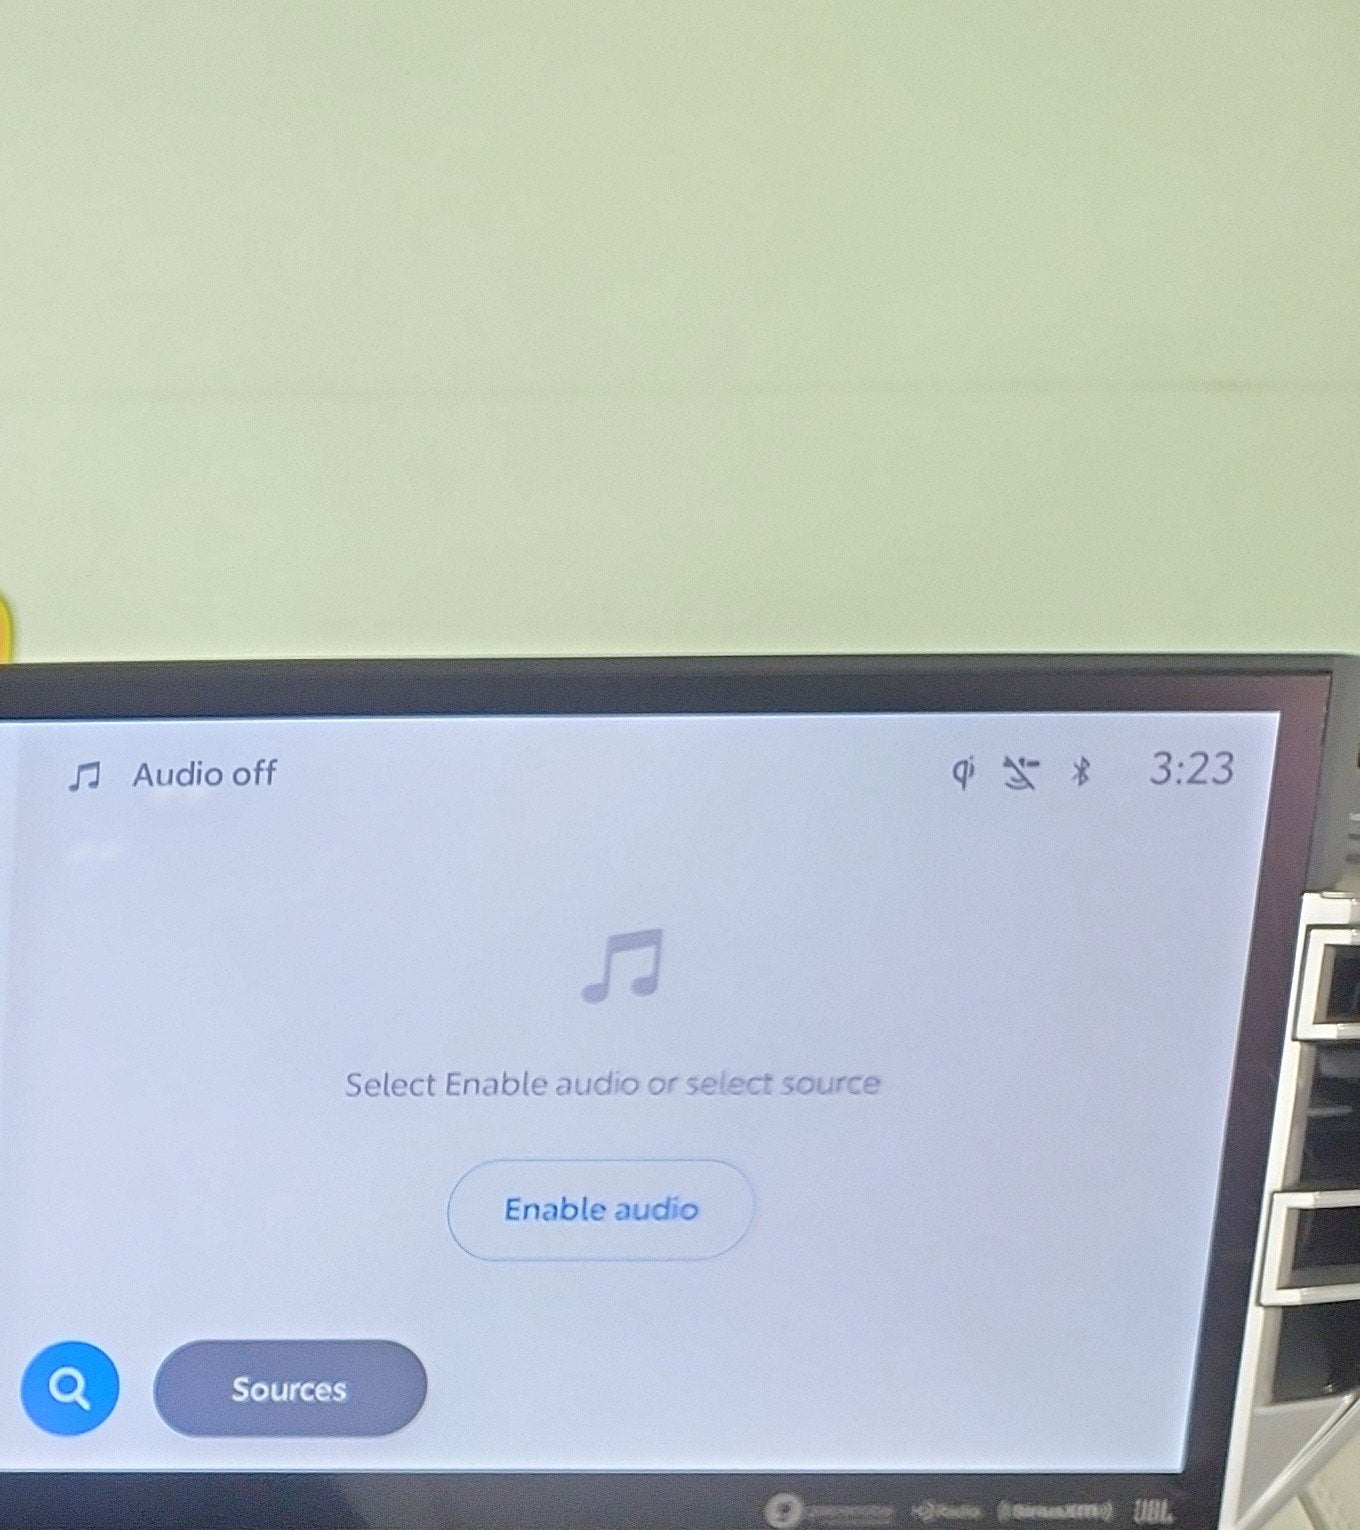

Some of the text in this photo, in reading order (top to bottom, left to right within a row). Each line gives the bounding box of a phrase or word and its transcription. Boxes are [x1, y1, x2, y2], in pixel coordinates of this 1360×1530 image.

[132, 758, 278, 787] Audio off
[1150, 750, 1235, 786] 3:23
[345, 1069, 882, 1099] Select Enable audio or select source
[504, 1196, 700, 1222] Enable audio
[231, 1375, 348, 1402] Sources
